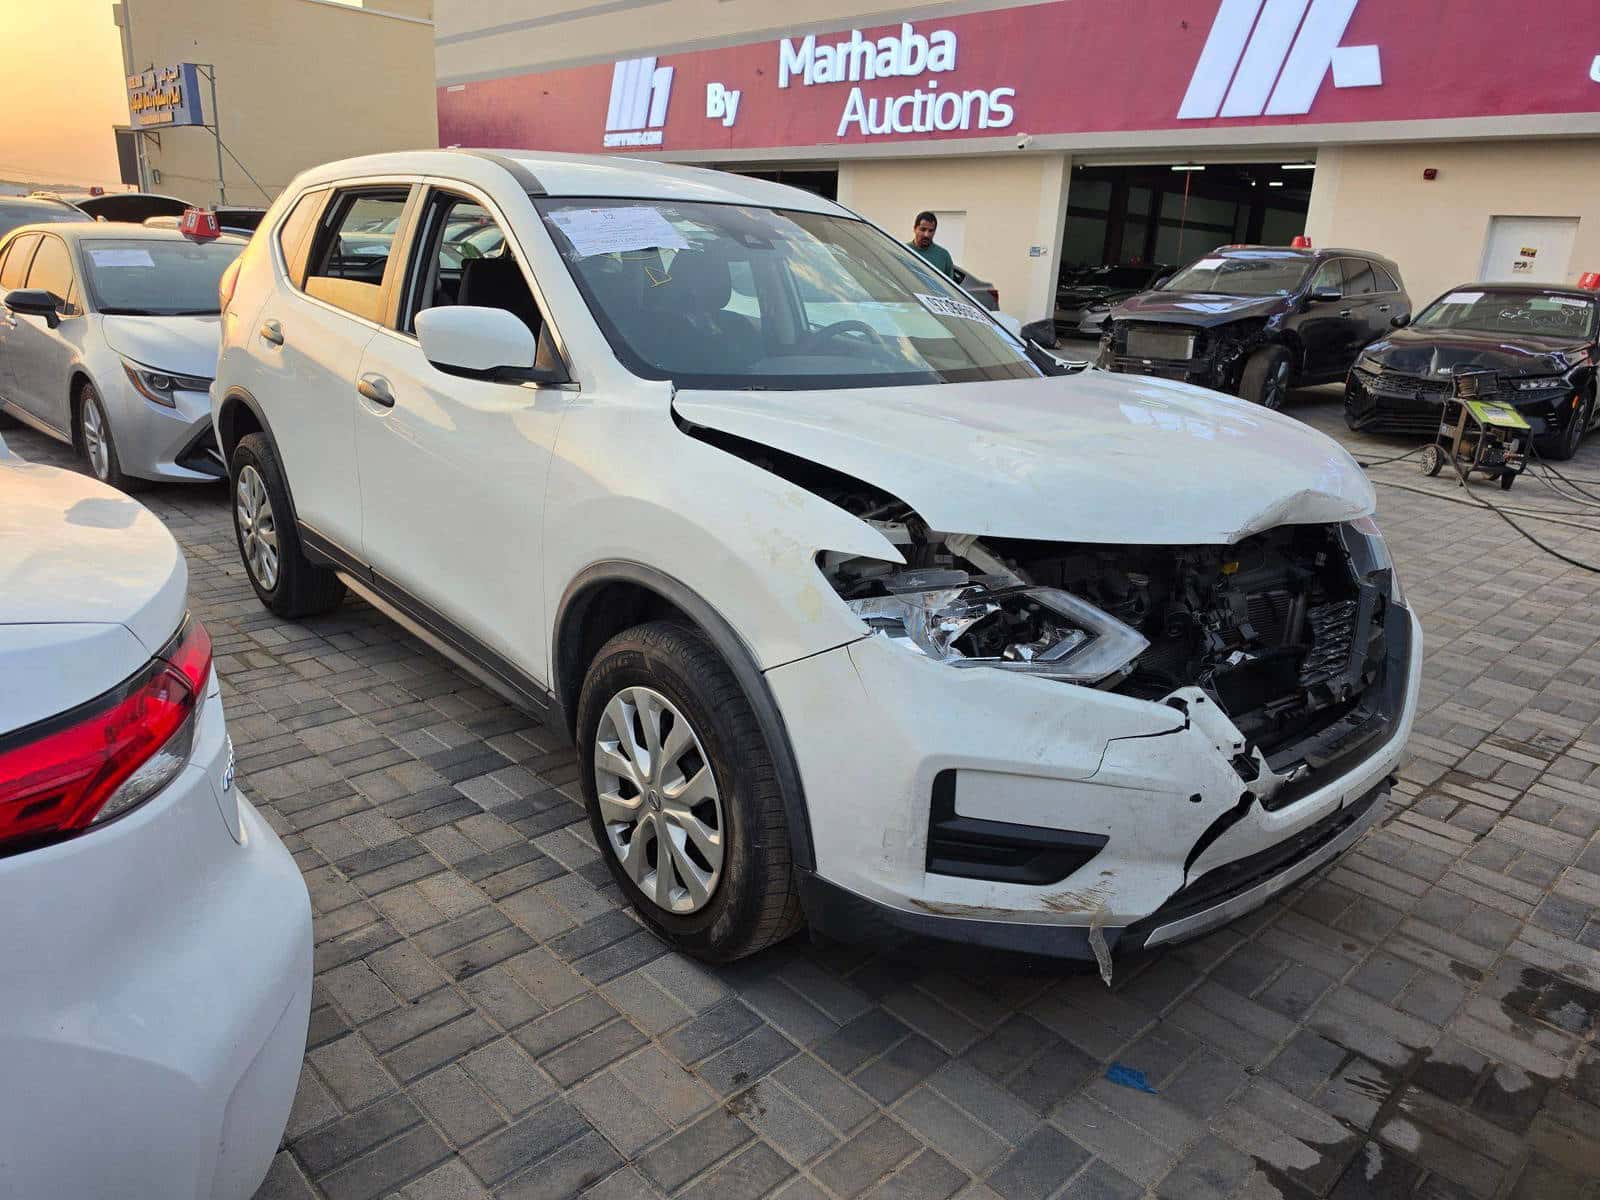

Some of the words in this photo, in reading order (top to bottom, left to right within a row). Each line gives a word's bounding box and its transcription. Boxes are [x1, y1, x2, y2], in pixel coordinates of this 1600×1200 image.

[778, 22, 957, 88] Marhaba
[706, 82, 740, 128] By
[836, 80, 1015, 137] Auctions
